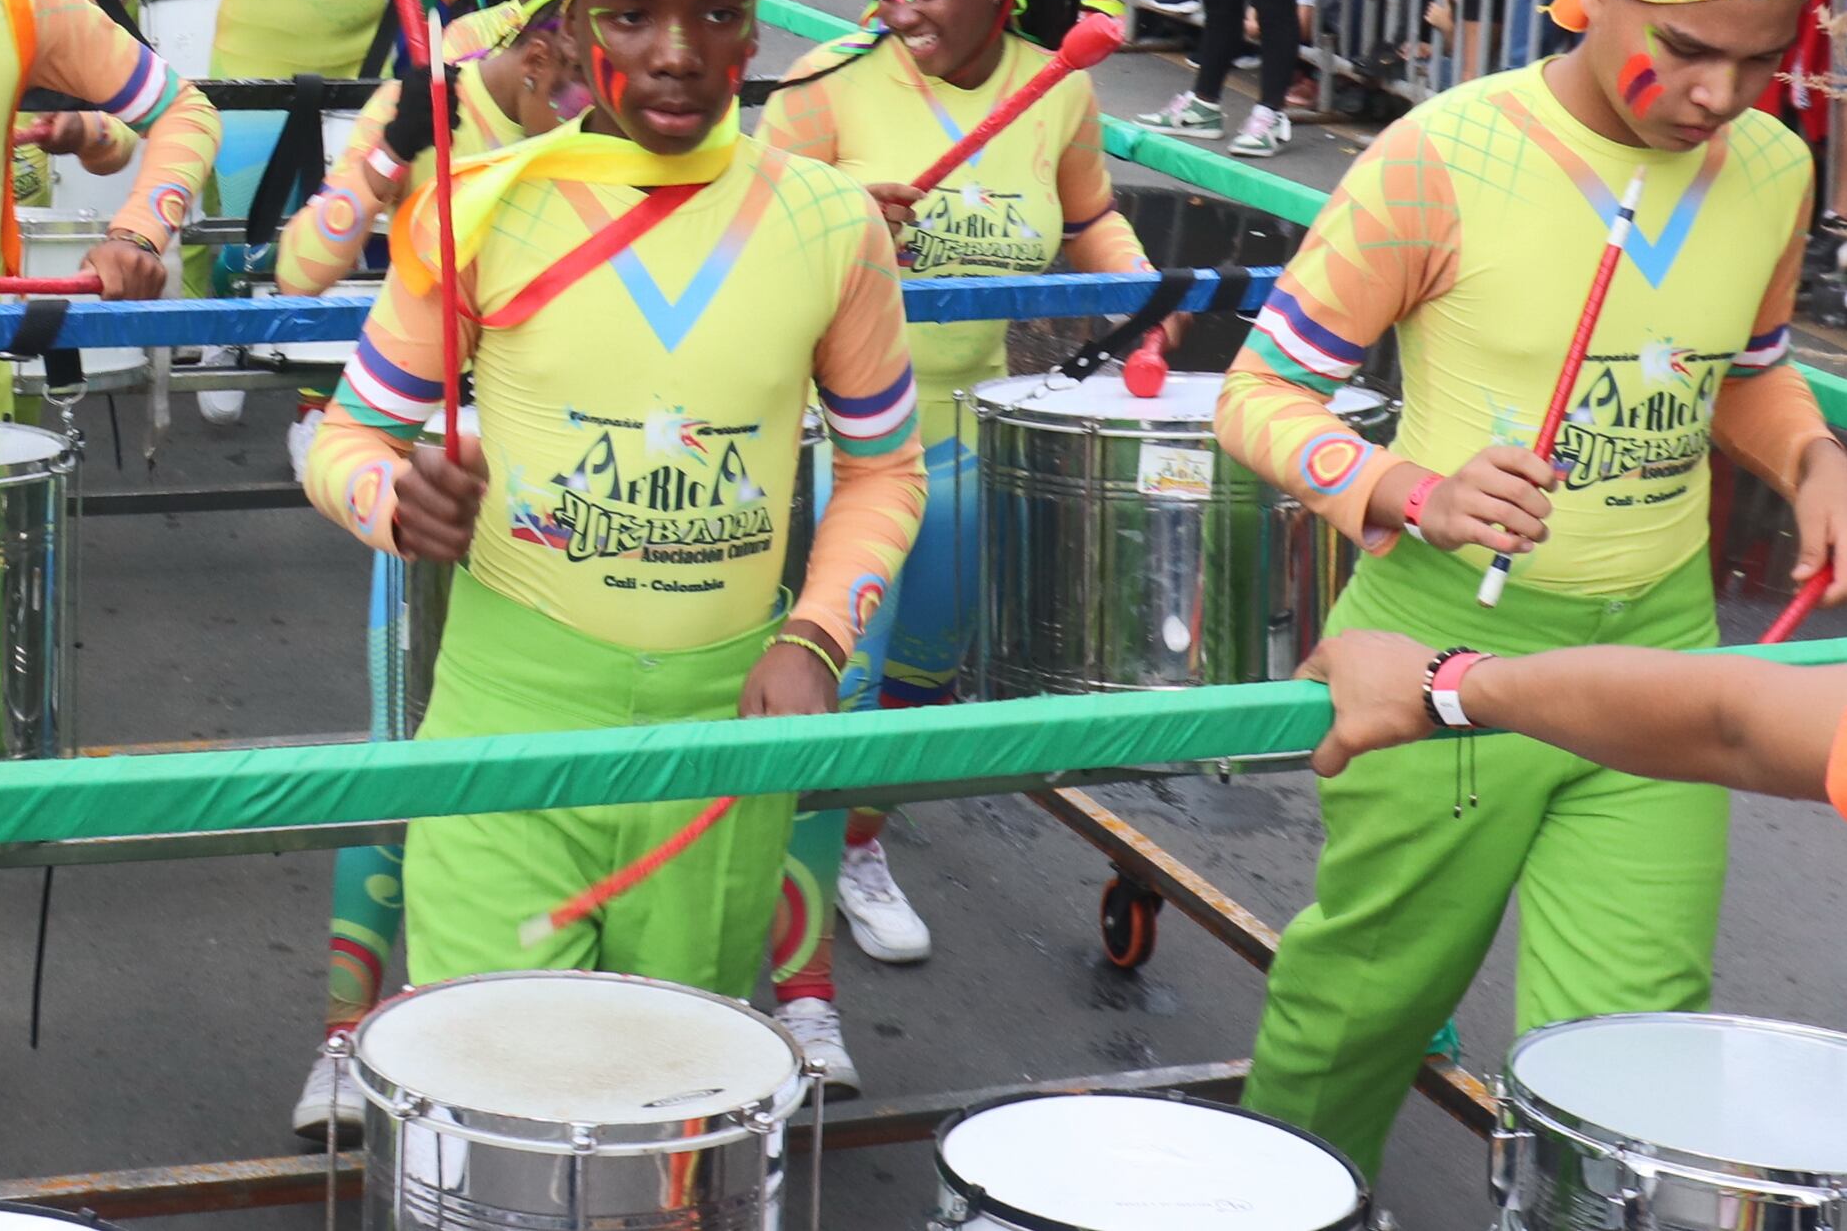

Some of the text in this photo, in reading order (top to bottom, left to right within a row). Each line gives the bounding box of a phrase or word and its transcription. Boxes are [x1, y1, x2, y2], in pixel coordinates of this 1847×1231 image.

[550, 431, 768, 513] AFRICA
[1605, 496, 1633, 507] Cali
[553, 489, 774, 563] URBANA
[603, 575, 637, 590] Cali
[650, 578, 725, 593] Colombia
